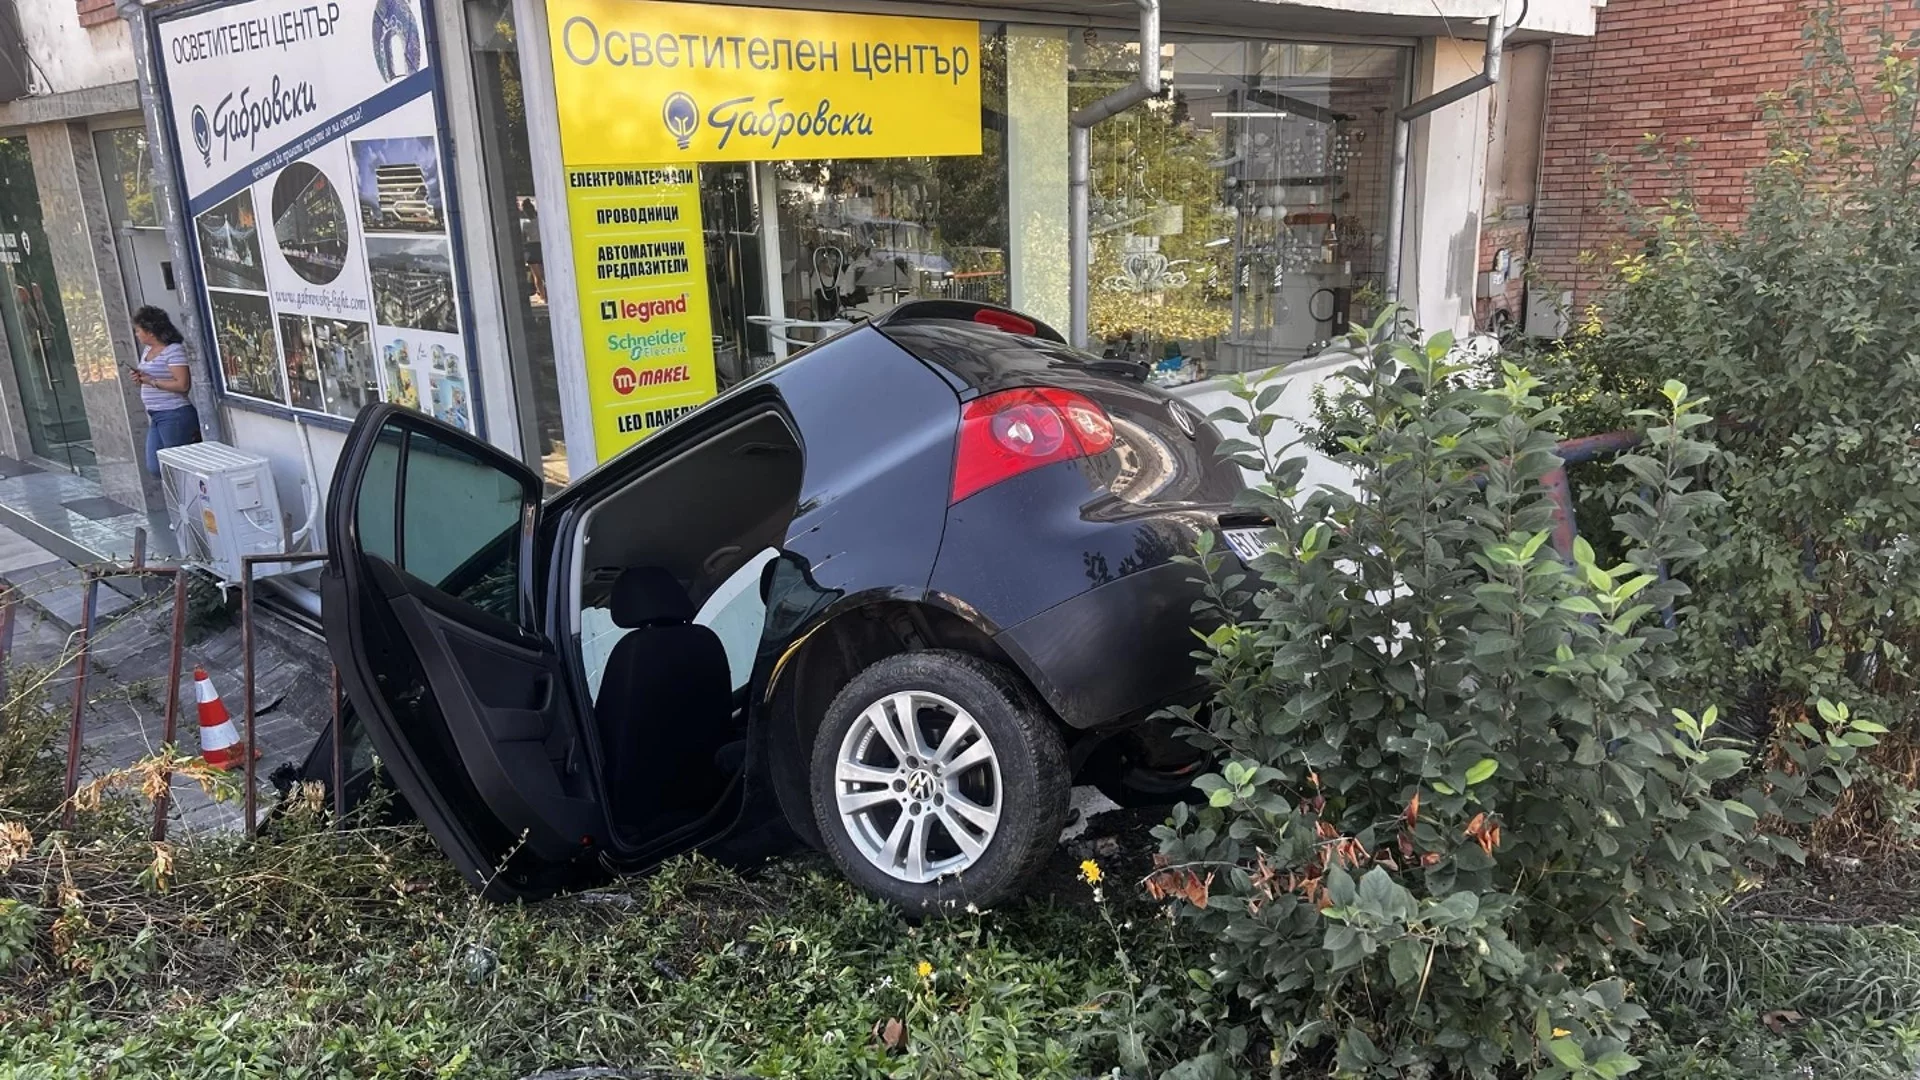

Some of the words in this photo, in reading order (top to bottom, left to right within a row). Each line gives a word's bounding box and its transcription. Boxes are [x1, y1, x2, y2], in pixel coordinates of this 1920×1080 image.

[172, 18, 270, 64] ОСВЕТИТЕЛЕН
[272, 2, 340, 52] ЦЕНТЪР
[563, 15, 838, 71] Осветителен
[852, 41, 969, 85] център
[213, 74, 317, 162] Габровски
[707, 96, 873, 150] Габровски
[569, 169, 693, 188] ЕЛЕКТРОМАТЕРИАЛИ
[596, 205, 679, 224] ПРОВОДНИЦИ
[598, 241, 685, 262] АВТОМАТИЧНИ
[597, 258, 689, 280] ПРЕДПАЗИТЕЛИ
[620, 293, 687, 323] legrand
[607, 328, 687, 352] Schneider
[639, 365, 690, 387] MAKEL
[618, 413, 643, 433] LED
[645, 404, 699, 429] ПАНЕ
